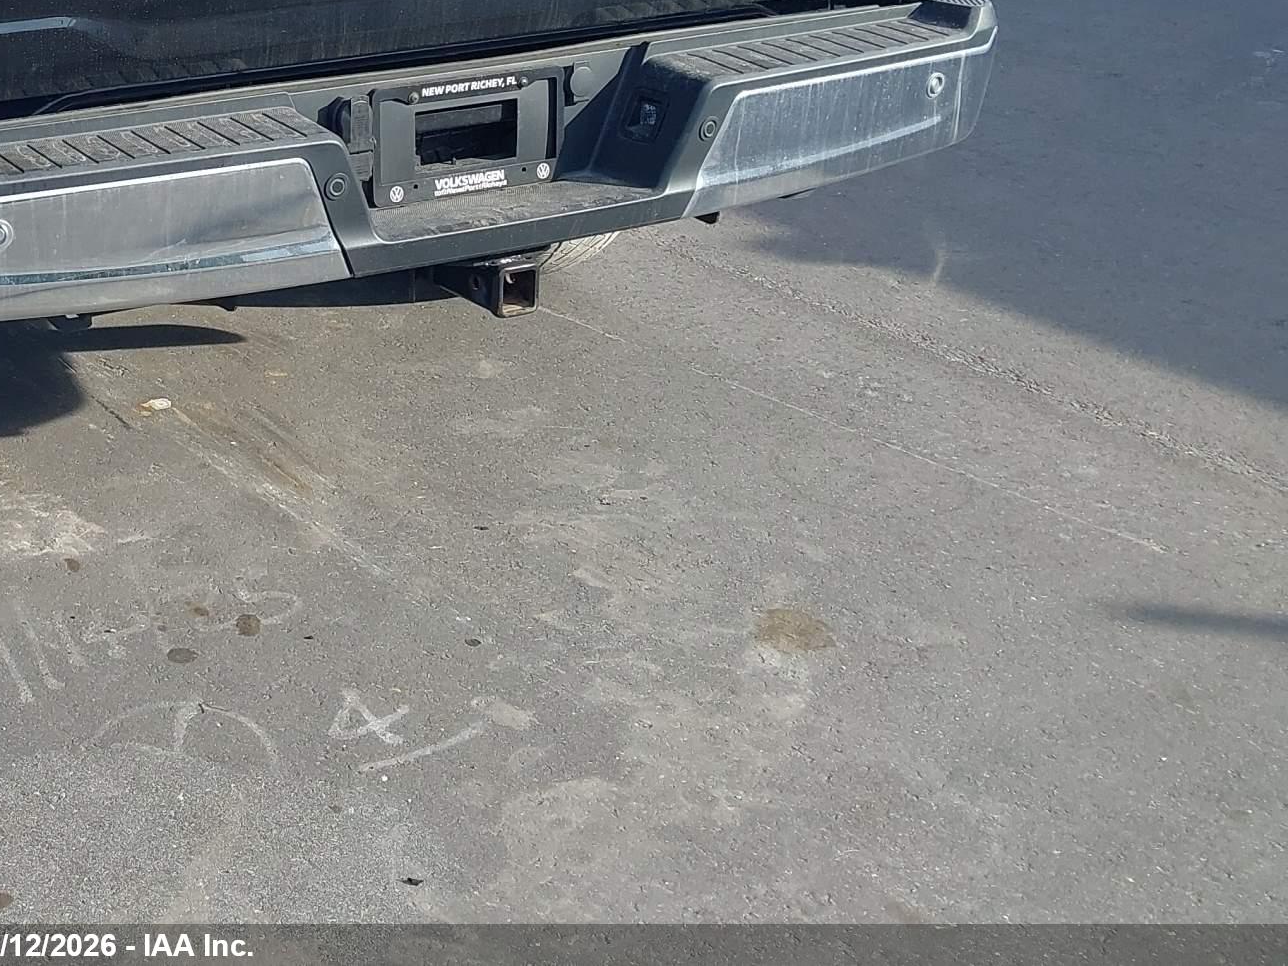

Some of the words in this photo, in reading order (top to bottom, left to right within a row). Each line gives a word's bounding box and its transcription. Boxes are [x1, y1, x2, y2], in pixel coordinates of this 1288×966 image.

[422, 85, 446, 97] NEW
[446, 83, 470, 94] PORT
[470, 77, 505, 90] RICHEY,
[506, 76, 517, 86] FL
[434, 169, 505, 190] VOLKSWAGEN
